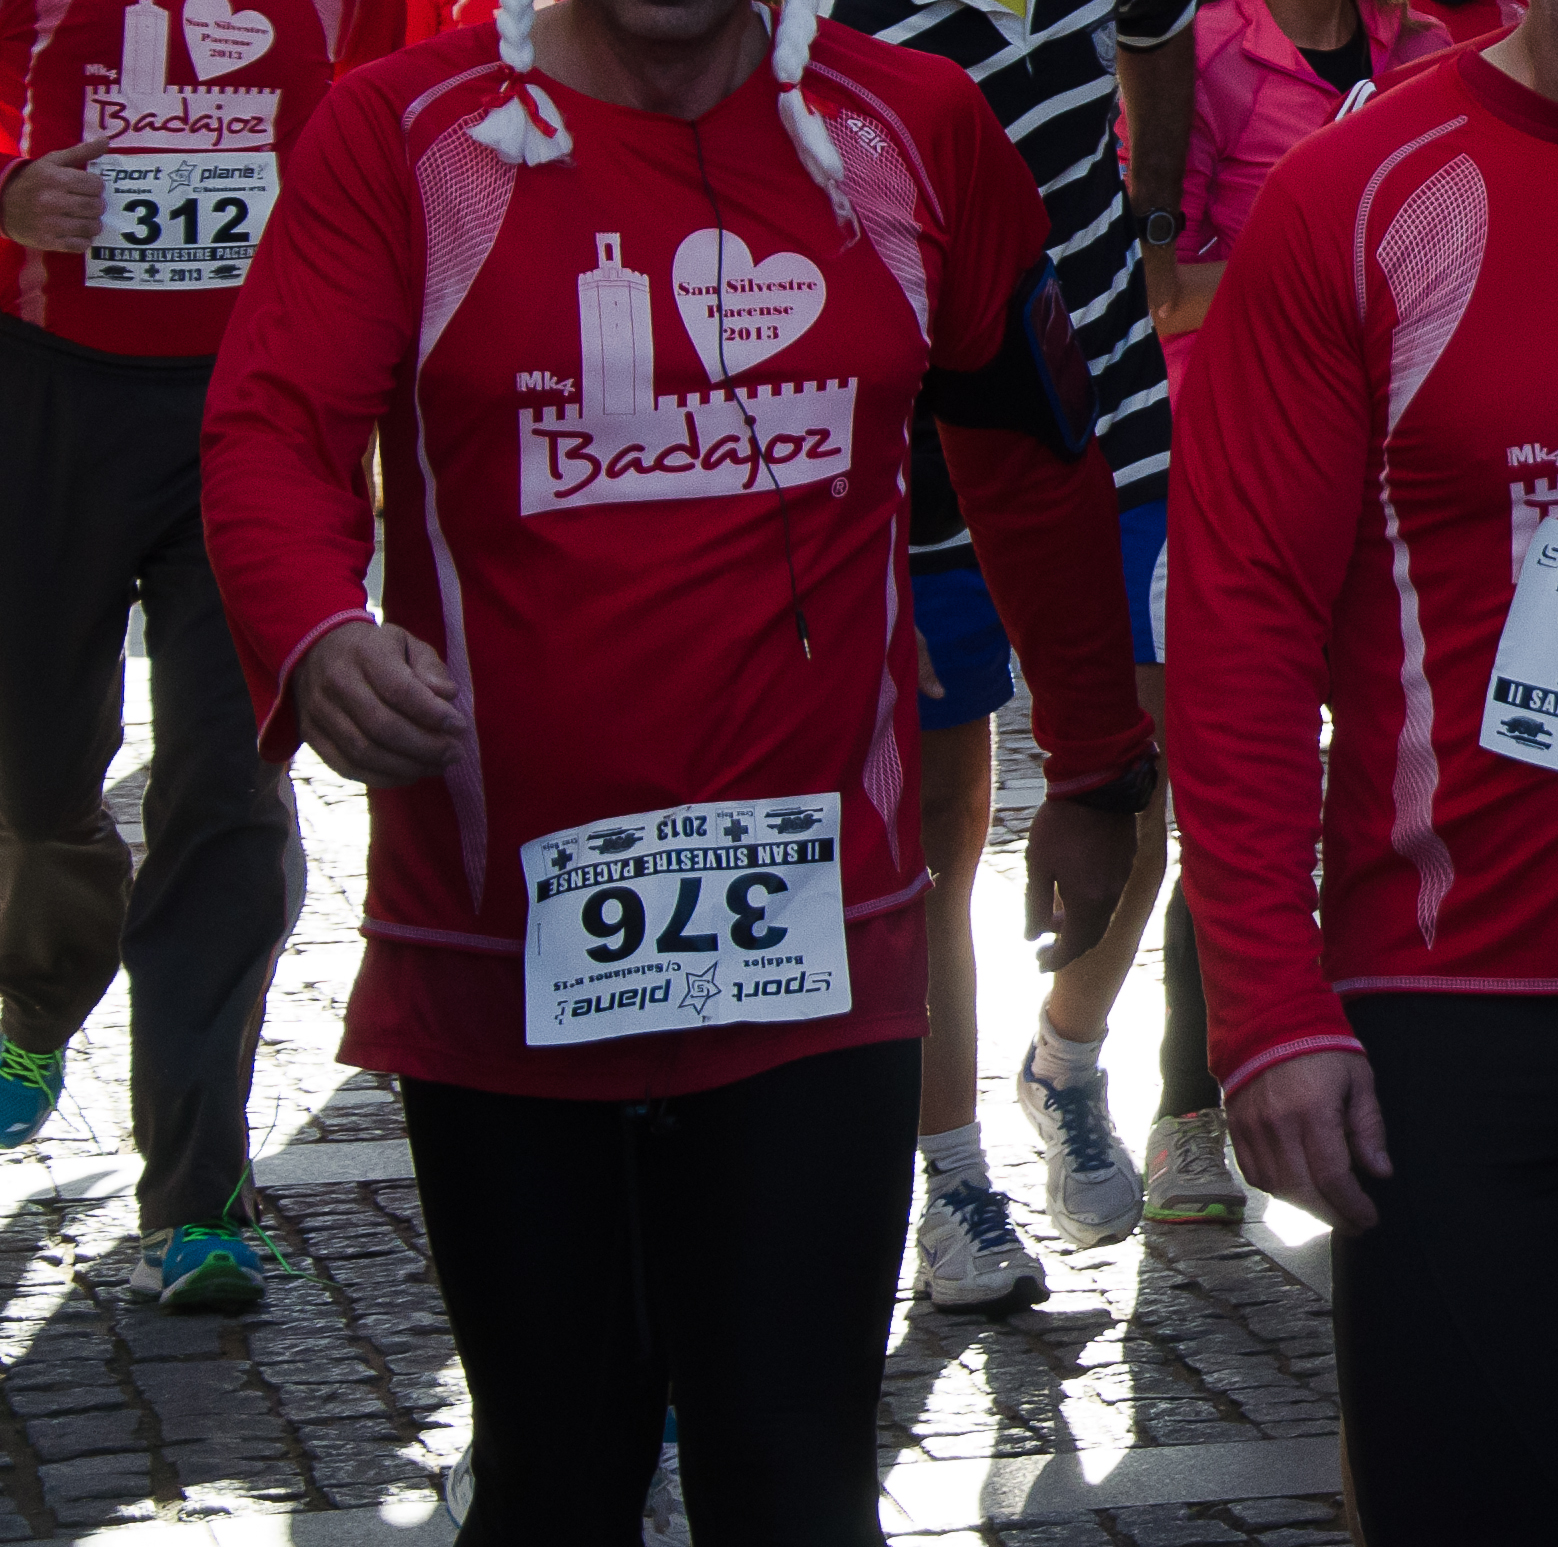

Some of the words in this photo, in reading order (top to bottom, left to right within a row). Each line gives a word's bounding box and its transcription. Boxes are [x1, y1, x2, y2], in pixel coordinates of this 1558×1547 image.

[185, 17, 210, 29] San
[210, 48, 244, 61] 2013
[91, 97, 267, 147] Badajoz
[846, 118, 888, 154] 42K
[120, 197, 250, 246] 312
[114, 248, 140, 261] SAN
[145, 248, 212, 261] SILVESTRE
[216, 246, 258, 259] PACEN
[170, 268, 202, 282] 2013
[677, 281, 719, 297] San
[726, 279, 818, 296] Silvestre
[707, 303, 794, 319] Pacense
[722, 325, 780, 342] 2013
[531, 411, 843, 499] Badajoz
[1507, 683, 1523, 704] II
[656, 814, 708, 841] 2013
[644, 847, 748, 874] SILVESTRE
[758, 843, 798, 864] SAN
[807, 841, 820, 860] II
[549, 859, 635, 894] PACENSE
[581, 871, 789, 964] 376
[743, 955, 805, 969] Badajoz
